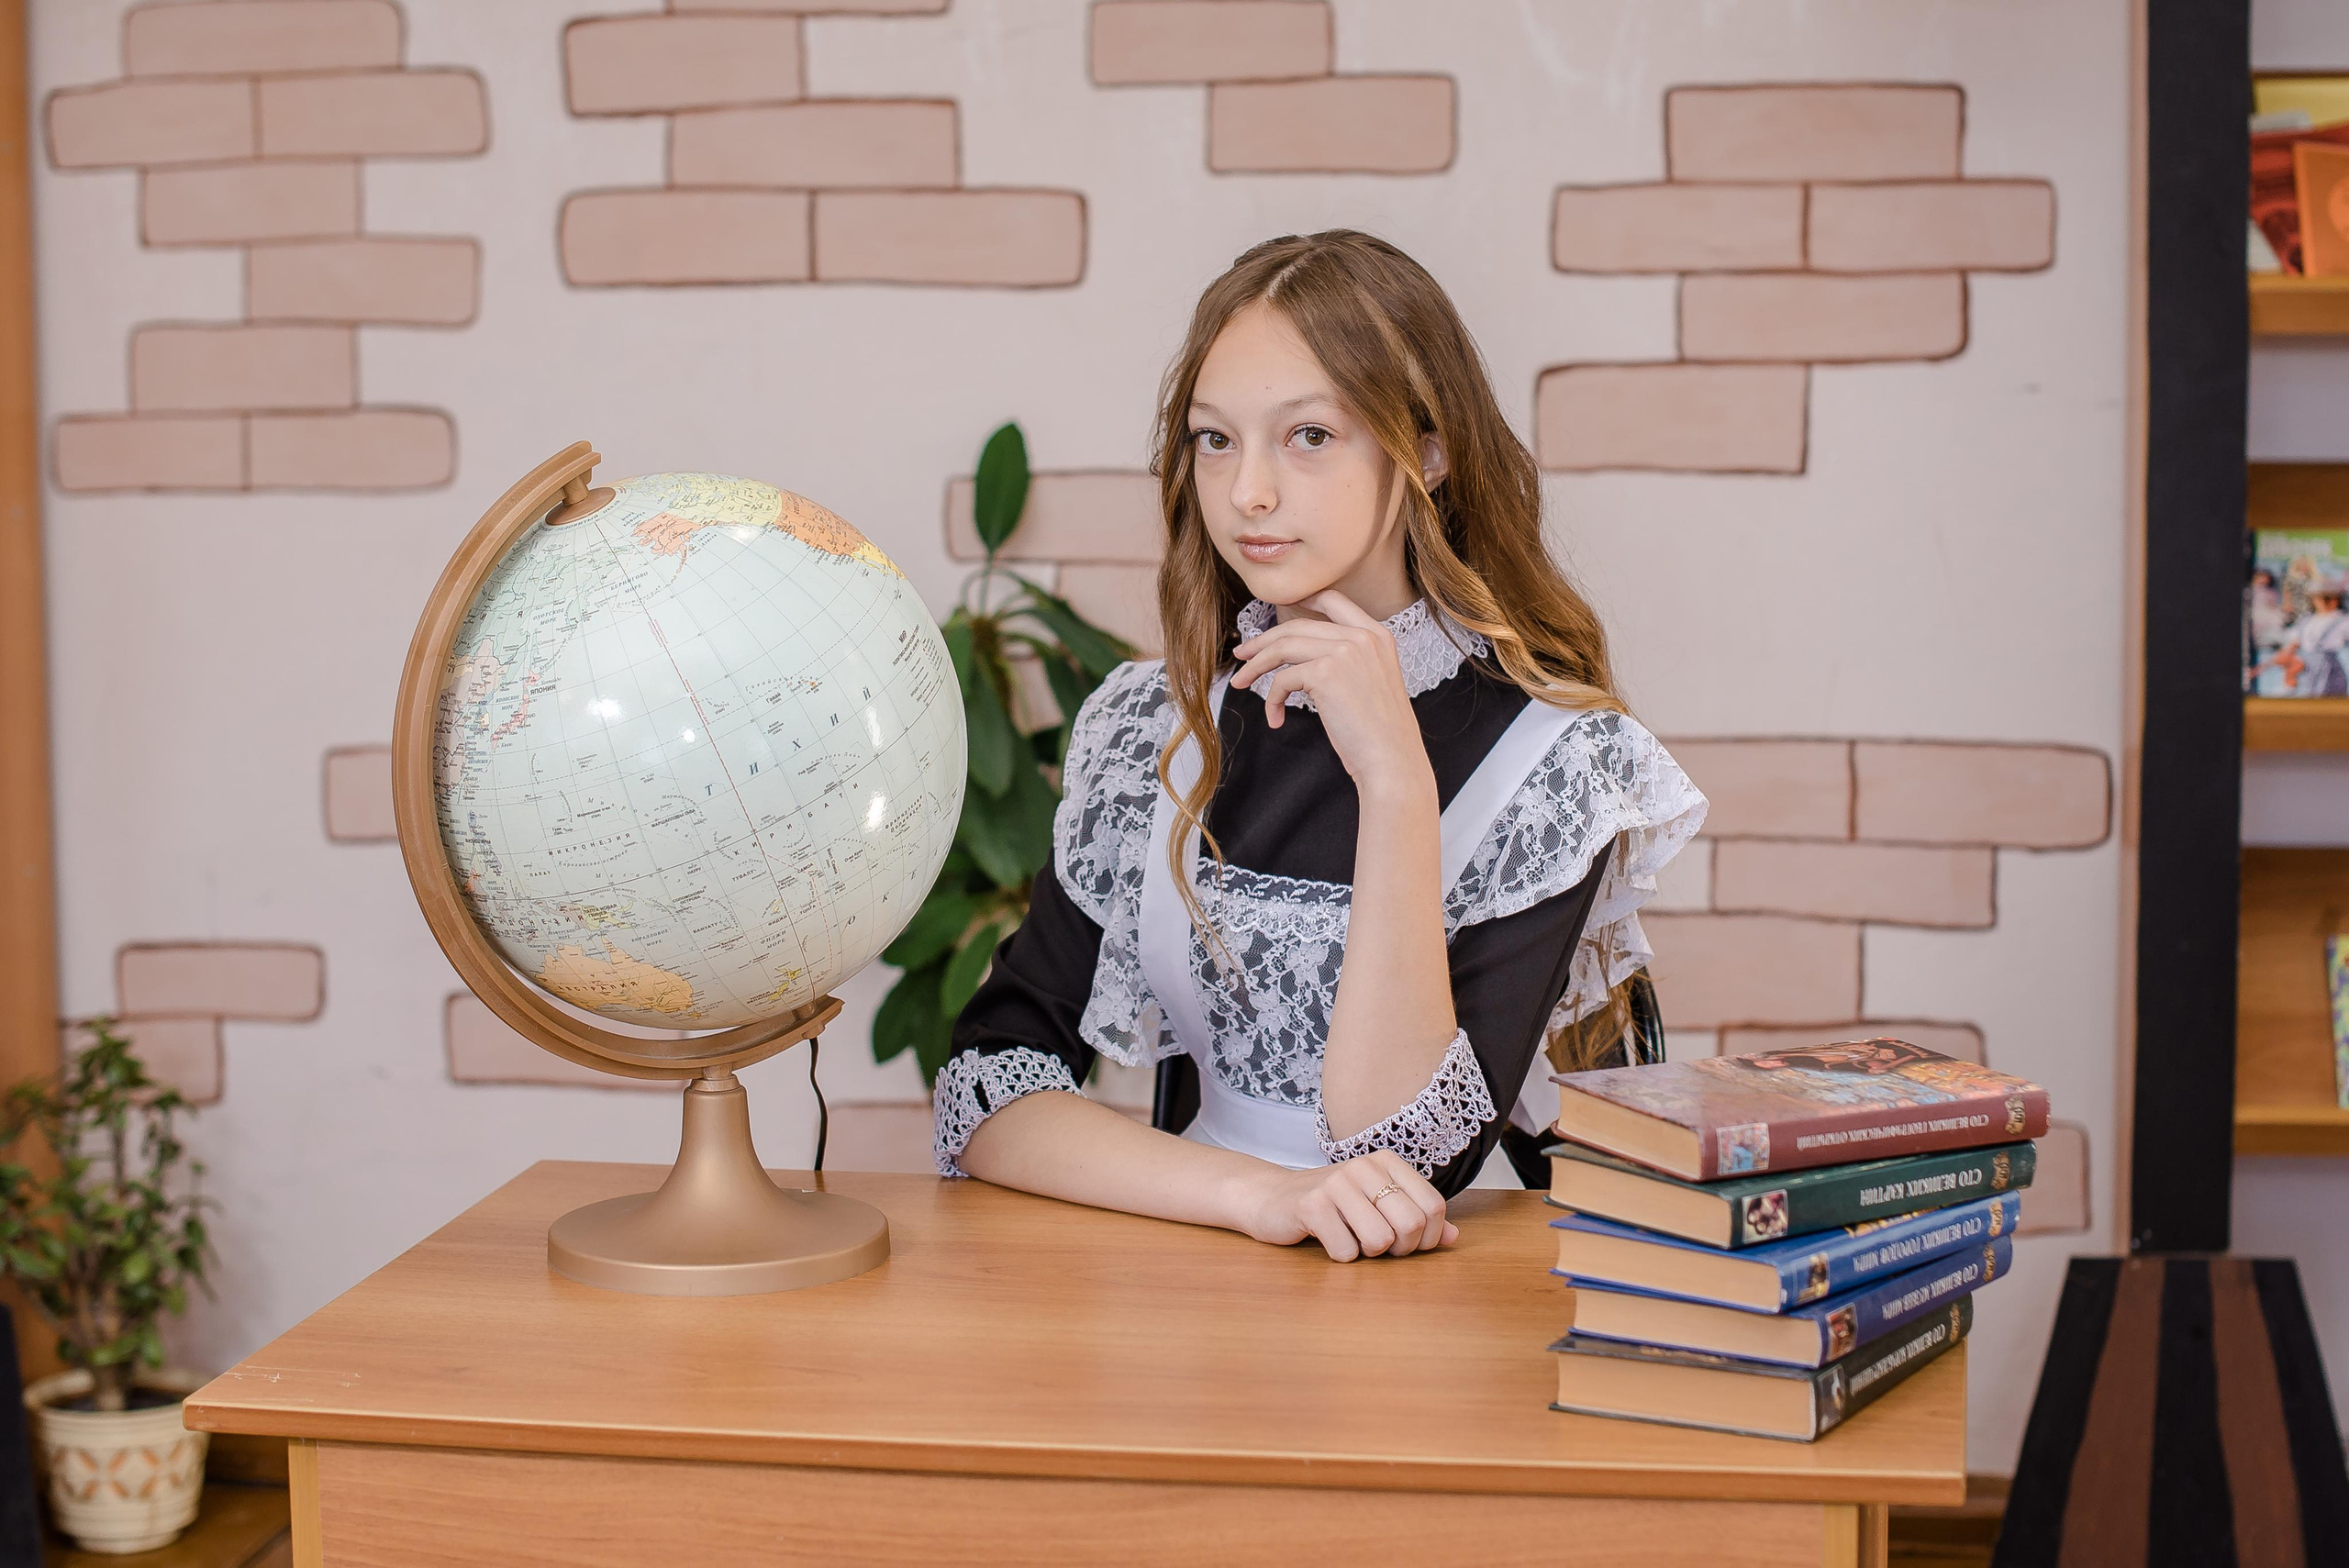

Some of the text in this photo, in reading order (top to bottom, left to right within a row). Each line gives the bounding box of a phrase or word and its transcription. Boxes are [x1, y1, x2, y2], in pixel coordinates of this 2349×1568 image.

[610, 572, 649, 591] БЕРИНГОВО
[624, 584, 642, 595] МОРЕ
[532, 607, 565, 621] ОХОТСКОЕ
[540, 617, 557, 626] МОРЕ
[529, 684, 556, 695] ЯПОНИЯ
[549, 832, 631, 856] МИКРОНЕЗИЯ
[686, 867, 702, 875] НАУРУ
[797, 862, 814, 874] САМОА
[732, 869, 754, 882] ТУВАЛУ
[673, 890, 705, 903] СОЛОМОНОВЫ
[679, 895, 701, 905] ОСТРОВА
[600, 904, 618, 912] НОВАЯ
[799, 904, 817, 915] ТОНГА
[693, 921, 718, 934] ВАНУАТУ
[767, 915, 787, 927] ФИДЖИ
[631, 929, 669, 942] КОРАЛЛОВОЕ
[760, 930, 787, 945] ФИДЖИ
[766, 938, 785, 950] МОРЕ
[558, 981, 639, 991] АВСТРАЛИЯ
[1797, 1114, 1989, 1151] СТО ВЕЛИКИХ ГЕОГРАФИЧЕСКИХ ОТКРЫТИЙ
[1860, 1168, 1983, 1207] СТО ВЕЛИКИХ КАРТИН
[1853, 1217, 1982, 1273] СТО ВЕЛИКИХ ГОРОДОВ МИРА
[1963, 1263, 1978, 1283] СТО
[1931, 1269, 1963, 1298] ВЕЛИКИХ
[1882, 1296, 1903, 1320] МИРА
[1932, 1323, 1945, 1344] СТО
[1906, 1330, 1932, 1360] ВЕЛИКИХ
